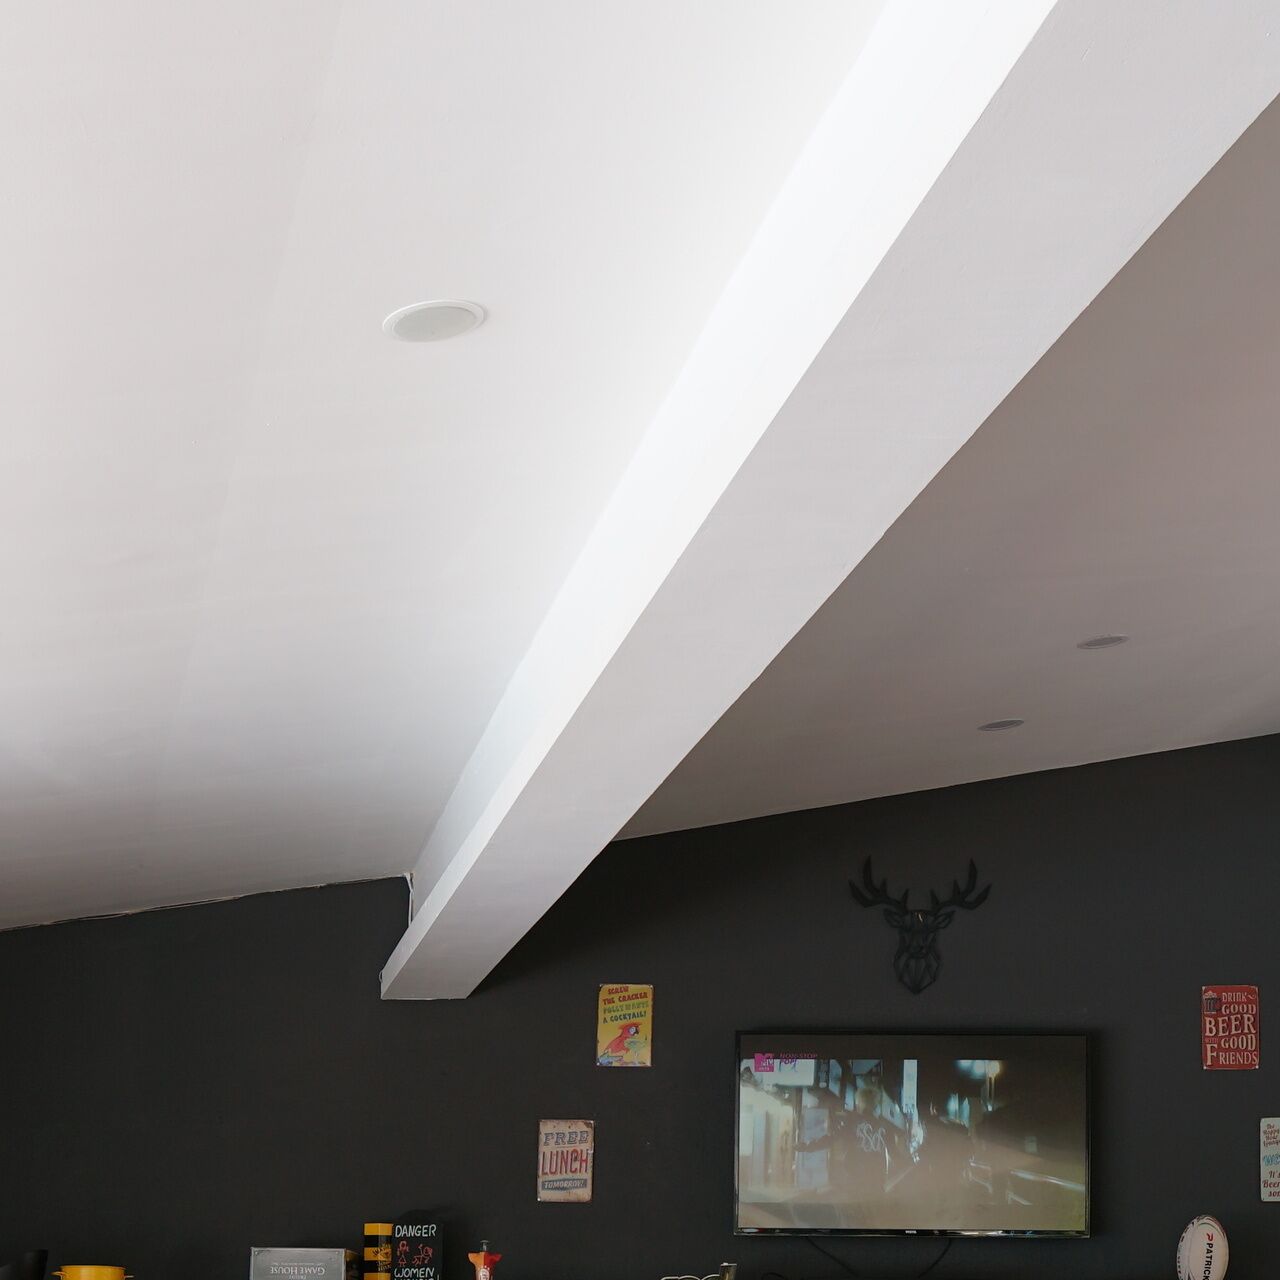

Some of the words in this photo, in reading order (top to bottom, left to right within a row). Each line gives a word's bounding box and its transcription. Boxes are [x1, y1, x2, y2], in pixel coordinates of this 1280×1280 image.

[1222, 992, 1247, 1002] DRINK
[1221, 1003, 1257, 1015] GOOD
[1204, 1014, 1257, 1037] BEER
[1221, 1034, 1257, 1051] GOOD
[1206, 1044, 1258, 1066] FRIENDS
[543, 1131, 589, 1147] FREE
[541, 1149, 589, 1176] LUNCH
[395, 1224, 437, 1238] DANGER
[270, 1266, 298, 1275] HOUSE
[394, 1267, 434, 1278] WOMEN
